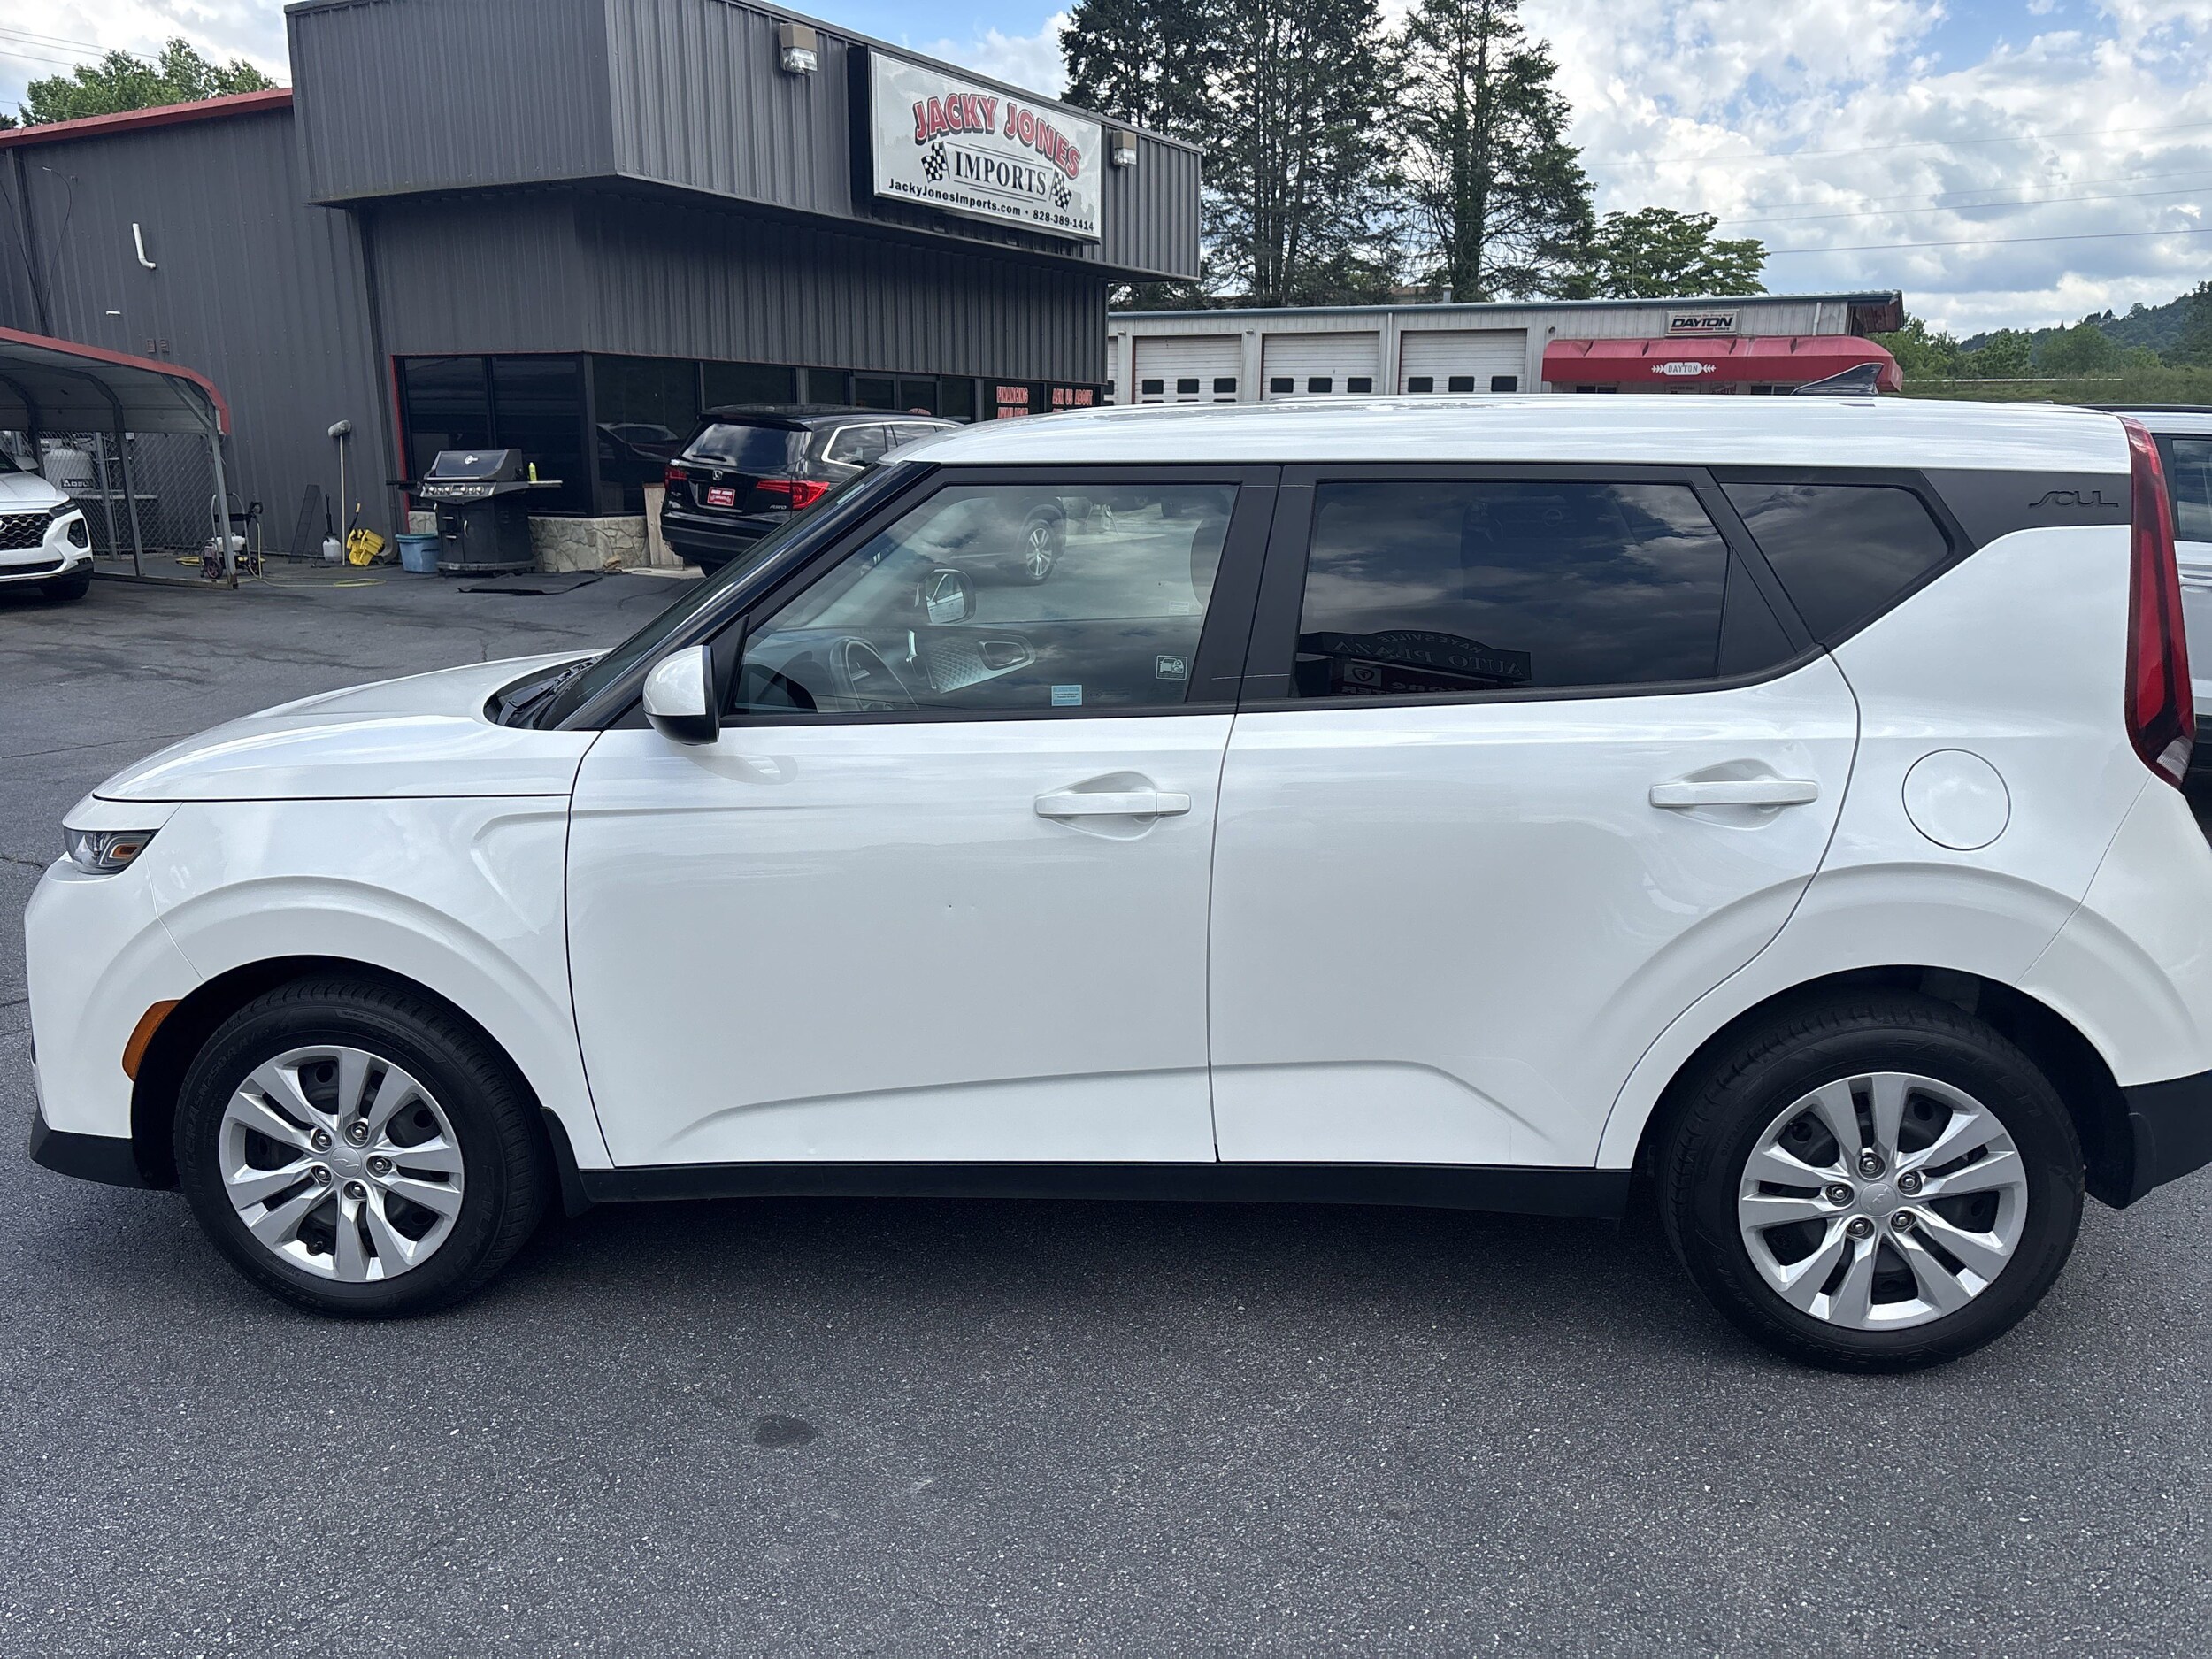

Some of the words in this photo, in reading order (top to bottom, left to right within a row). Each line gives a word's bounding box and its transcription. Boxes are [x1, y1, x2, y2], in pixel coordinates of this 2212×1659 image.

[913, 93, 998, 145] JACKY
[1004, 103, 1081, 180] JONES
[955, 150, 1047, 196] IMPORTS
[888, 178, 1021, 216] JackyJonesImports.com
[1033, 210, 1094, 232] 828-389-1414
[1671, 318, 1733, 327] DAYTON
[1668, 365, 1698, 373] DAYTON
[2028, 490, 2119, 509] SOUL
